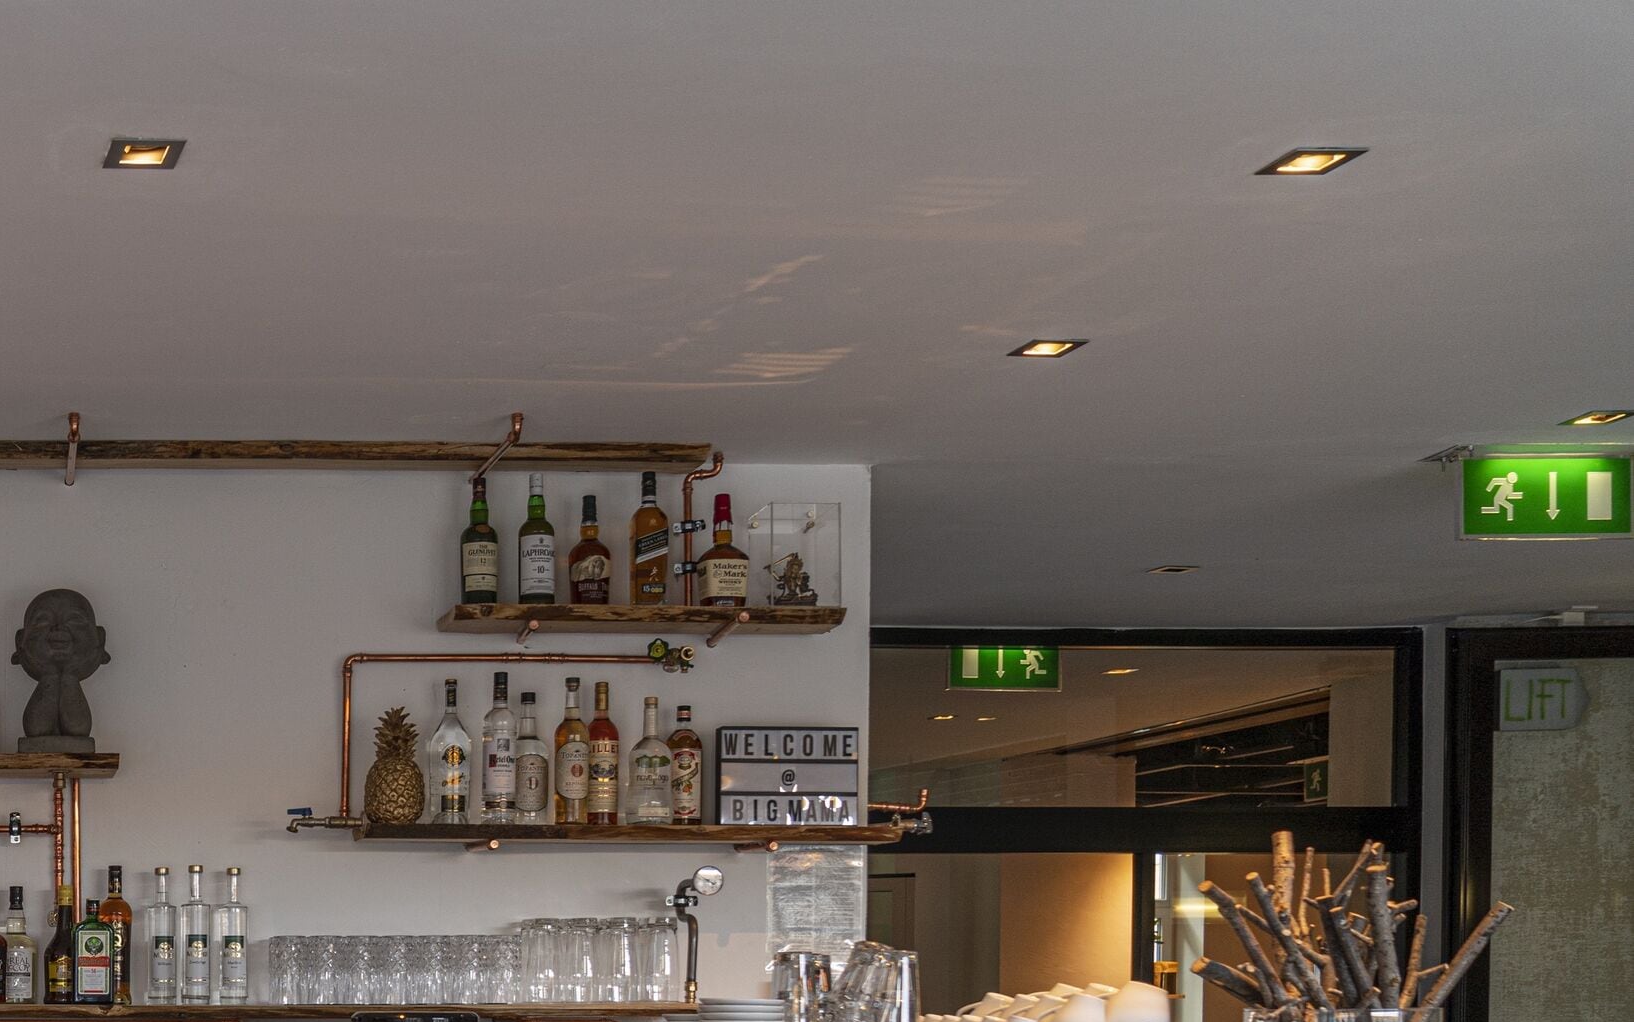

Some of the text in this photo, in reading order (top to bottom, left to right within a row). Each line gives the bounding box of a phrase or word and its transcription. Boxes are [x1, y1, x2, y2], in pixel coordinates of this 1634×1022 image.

[1504, 678, 1572, 722] LIFT
[724, 733, 853, 756] WELCOME
[732, 799, 850, 822] BIG MAMA
